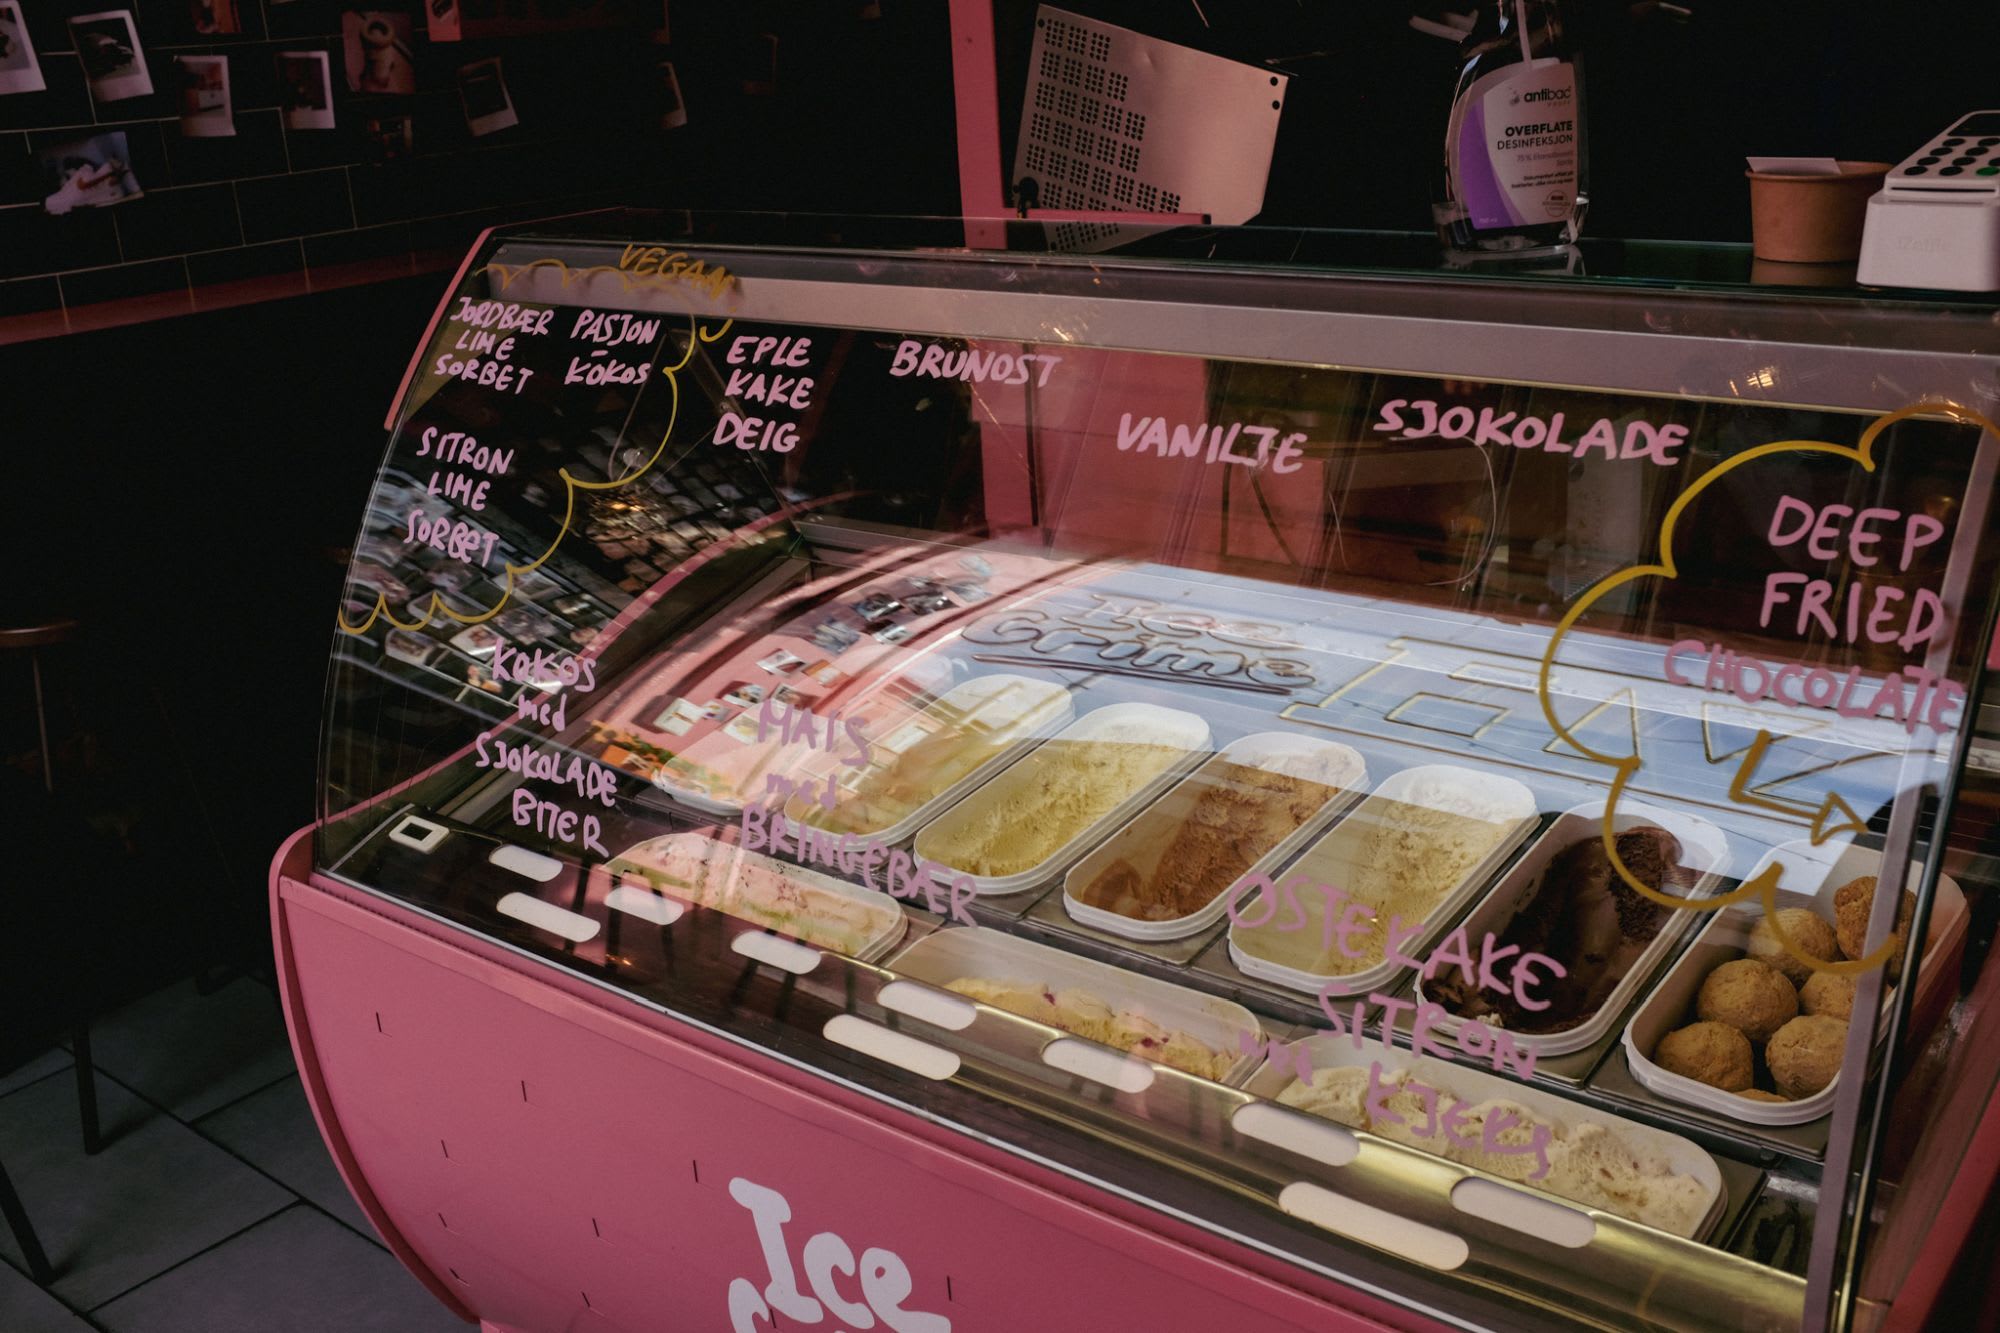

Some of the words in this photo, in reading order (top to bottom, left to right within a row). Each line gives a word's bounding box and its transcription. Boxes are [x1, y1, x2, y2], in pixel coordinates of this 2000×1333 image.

[1524, 88, 1572, 103] antibac
[1498, 134, 1573, 150] DESINFEKSJON
[1505, 120, 1573, 137] OVERFLATE
[620, 244, 735, 301] VEGAN
[450, 297, 554, 335] JORDBÆR
[570, 310, 660, 346] PASJON
[456, 330, 514, 361] LIME
[726, 336, 812, 368] EPLE
[889, 339, 1063, 388] BRUNOST
[434, 354, 533, 394] SORBET
[564, 357, 651, 386] KOKOS
[725, 369, 814, 409] KAKE
[416, 426, 514, 475] SITRON
[712, 412, 800, 453] DEIG
[1117, 412, 1307, 474] VANILJE
[1373, 399, 1690, 466] SJOKOLADE
[428, 472, 491, 511] LIME
[1768, 495, 1945, 572] DEEP
[1760, 572, 1945, 652] FRIED
[492, 640, 597, 692] KOKOS
[1664, 640, 1967, 734] CHOCOLATE
[519, 694, 566, 731] med
[757, 700, 870, 767] MAIS
[475, 731, 618, 807] SJOKOLADE
[513, 788, 609, 858] BITER
[741, 802, 978, 928] BRINGEBÆR
[1317, 983, 1541, 1081] SITRON
[1364, 1061, 1552, 1180] KJEKS
[728, 1177, 952, 1333] Ice
